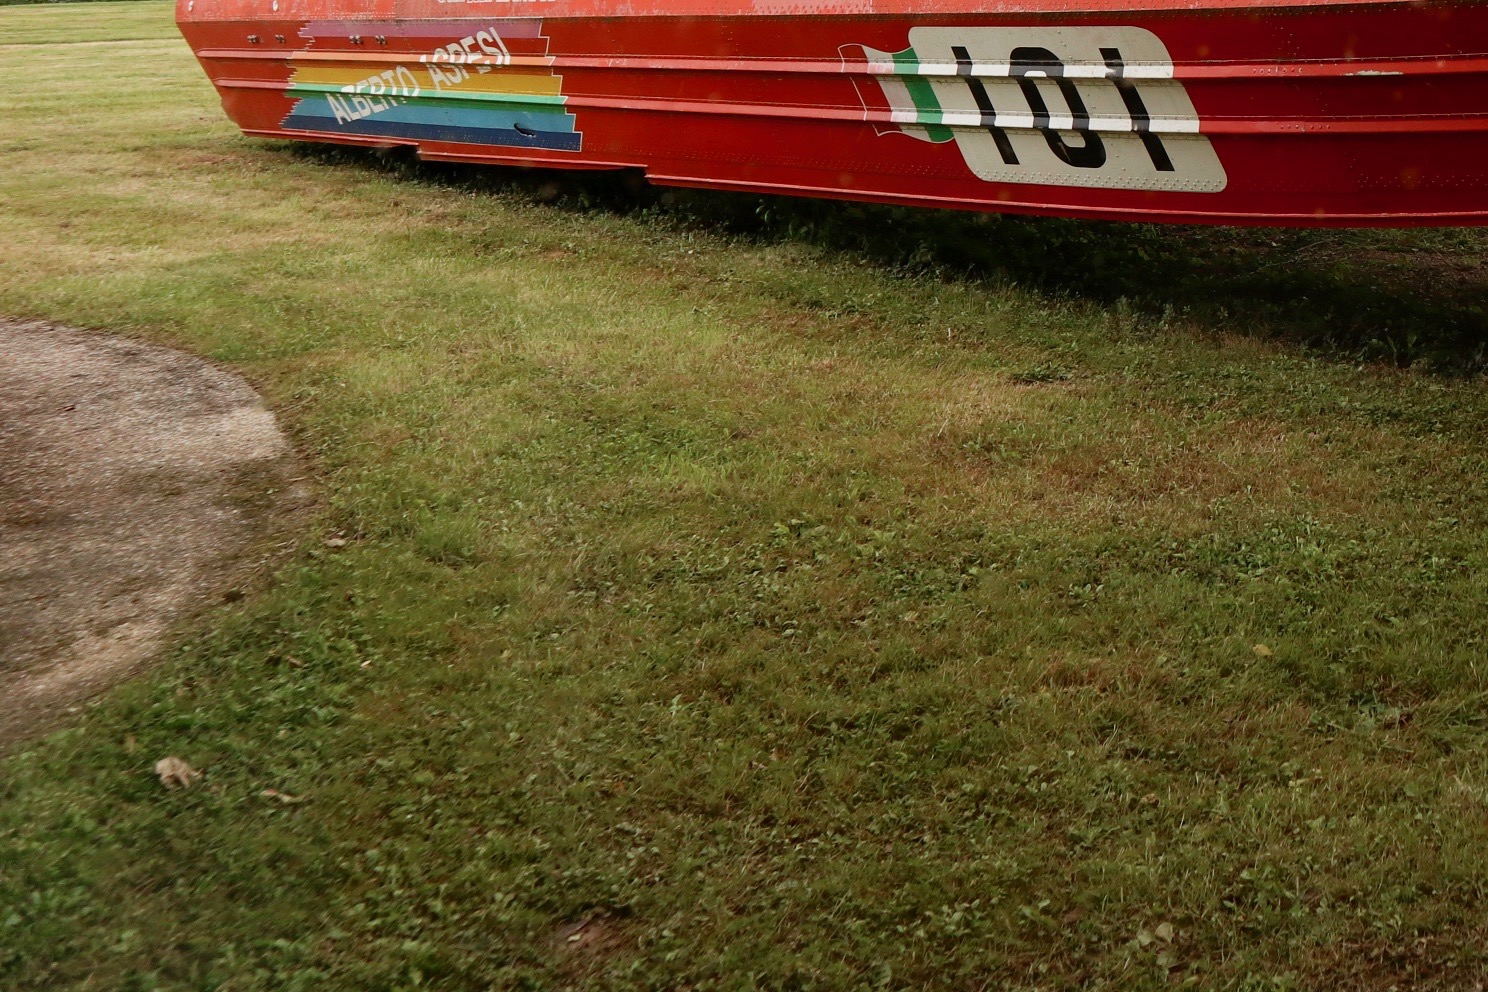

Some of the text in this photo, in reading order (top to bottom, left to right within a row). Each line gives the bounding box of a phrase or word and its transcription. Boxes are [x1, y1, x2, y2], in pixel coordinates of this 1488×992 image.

[420, 26, 511, 91] ASPESI
[325, 65, 420, 125] ALBERTO
[951, 45, 1175, 172] 101
